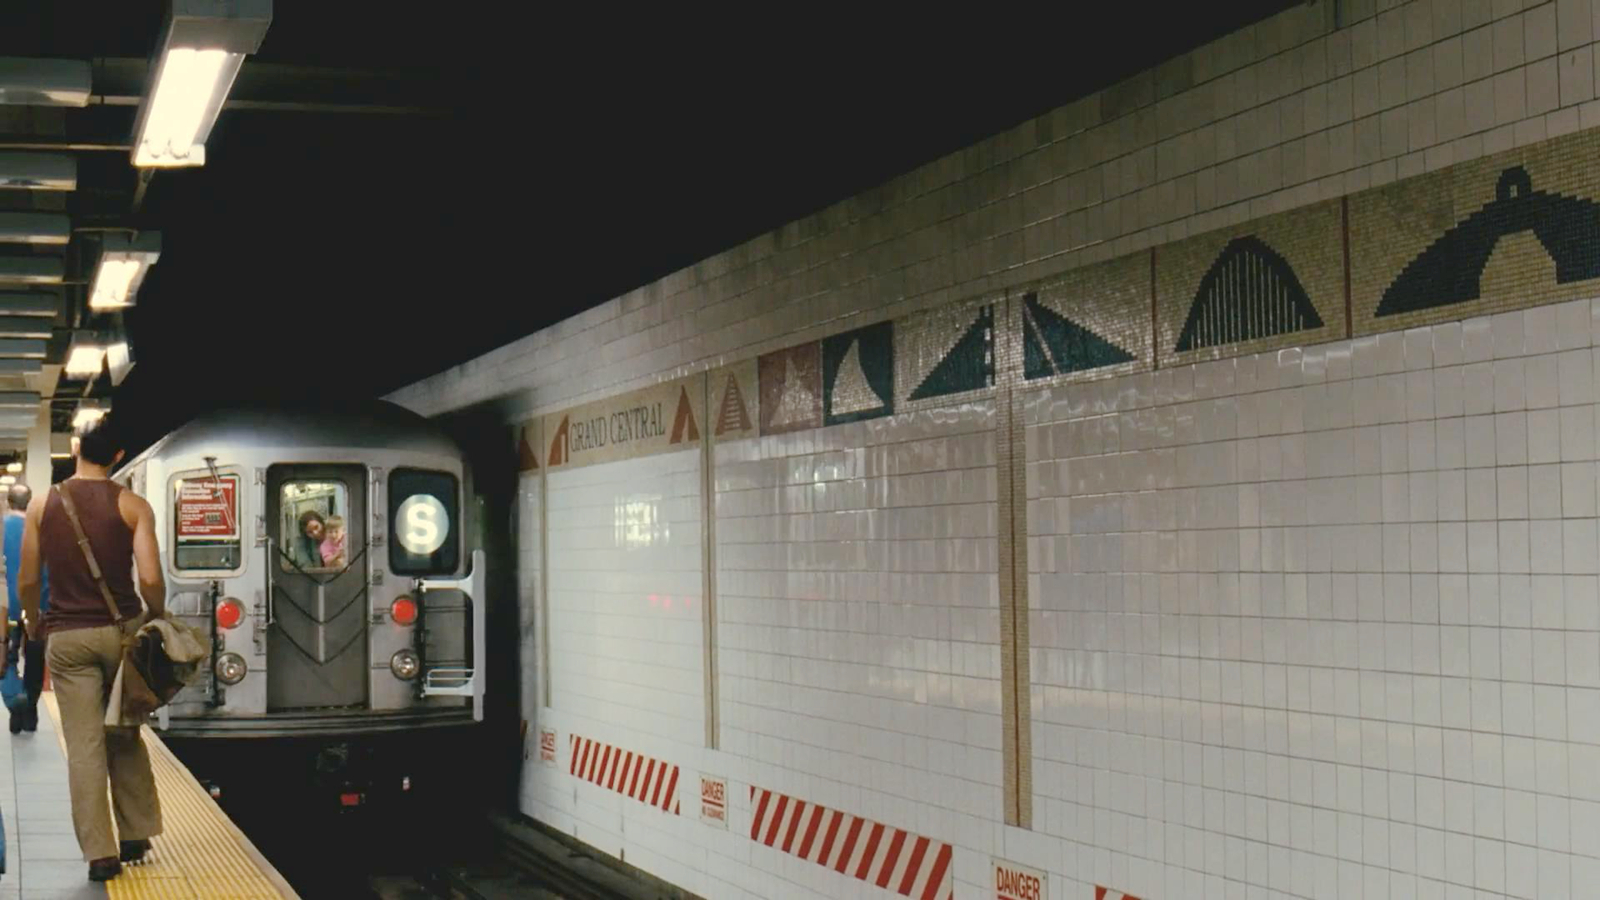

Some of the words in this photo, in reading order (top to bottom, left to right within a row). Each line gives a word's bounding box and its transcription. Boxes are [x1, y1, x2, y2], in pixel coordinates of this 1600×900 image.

[570, 416, 607, 452] GRAND
[610, 402, 666, 444] CENTRAL
[406, 502, 438, 545] S
[996, 866, 1040, 900] DANGER
